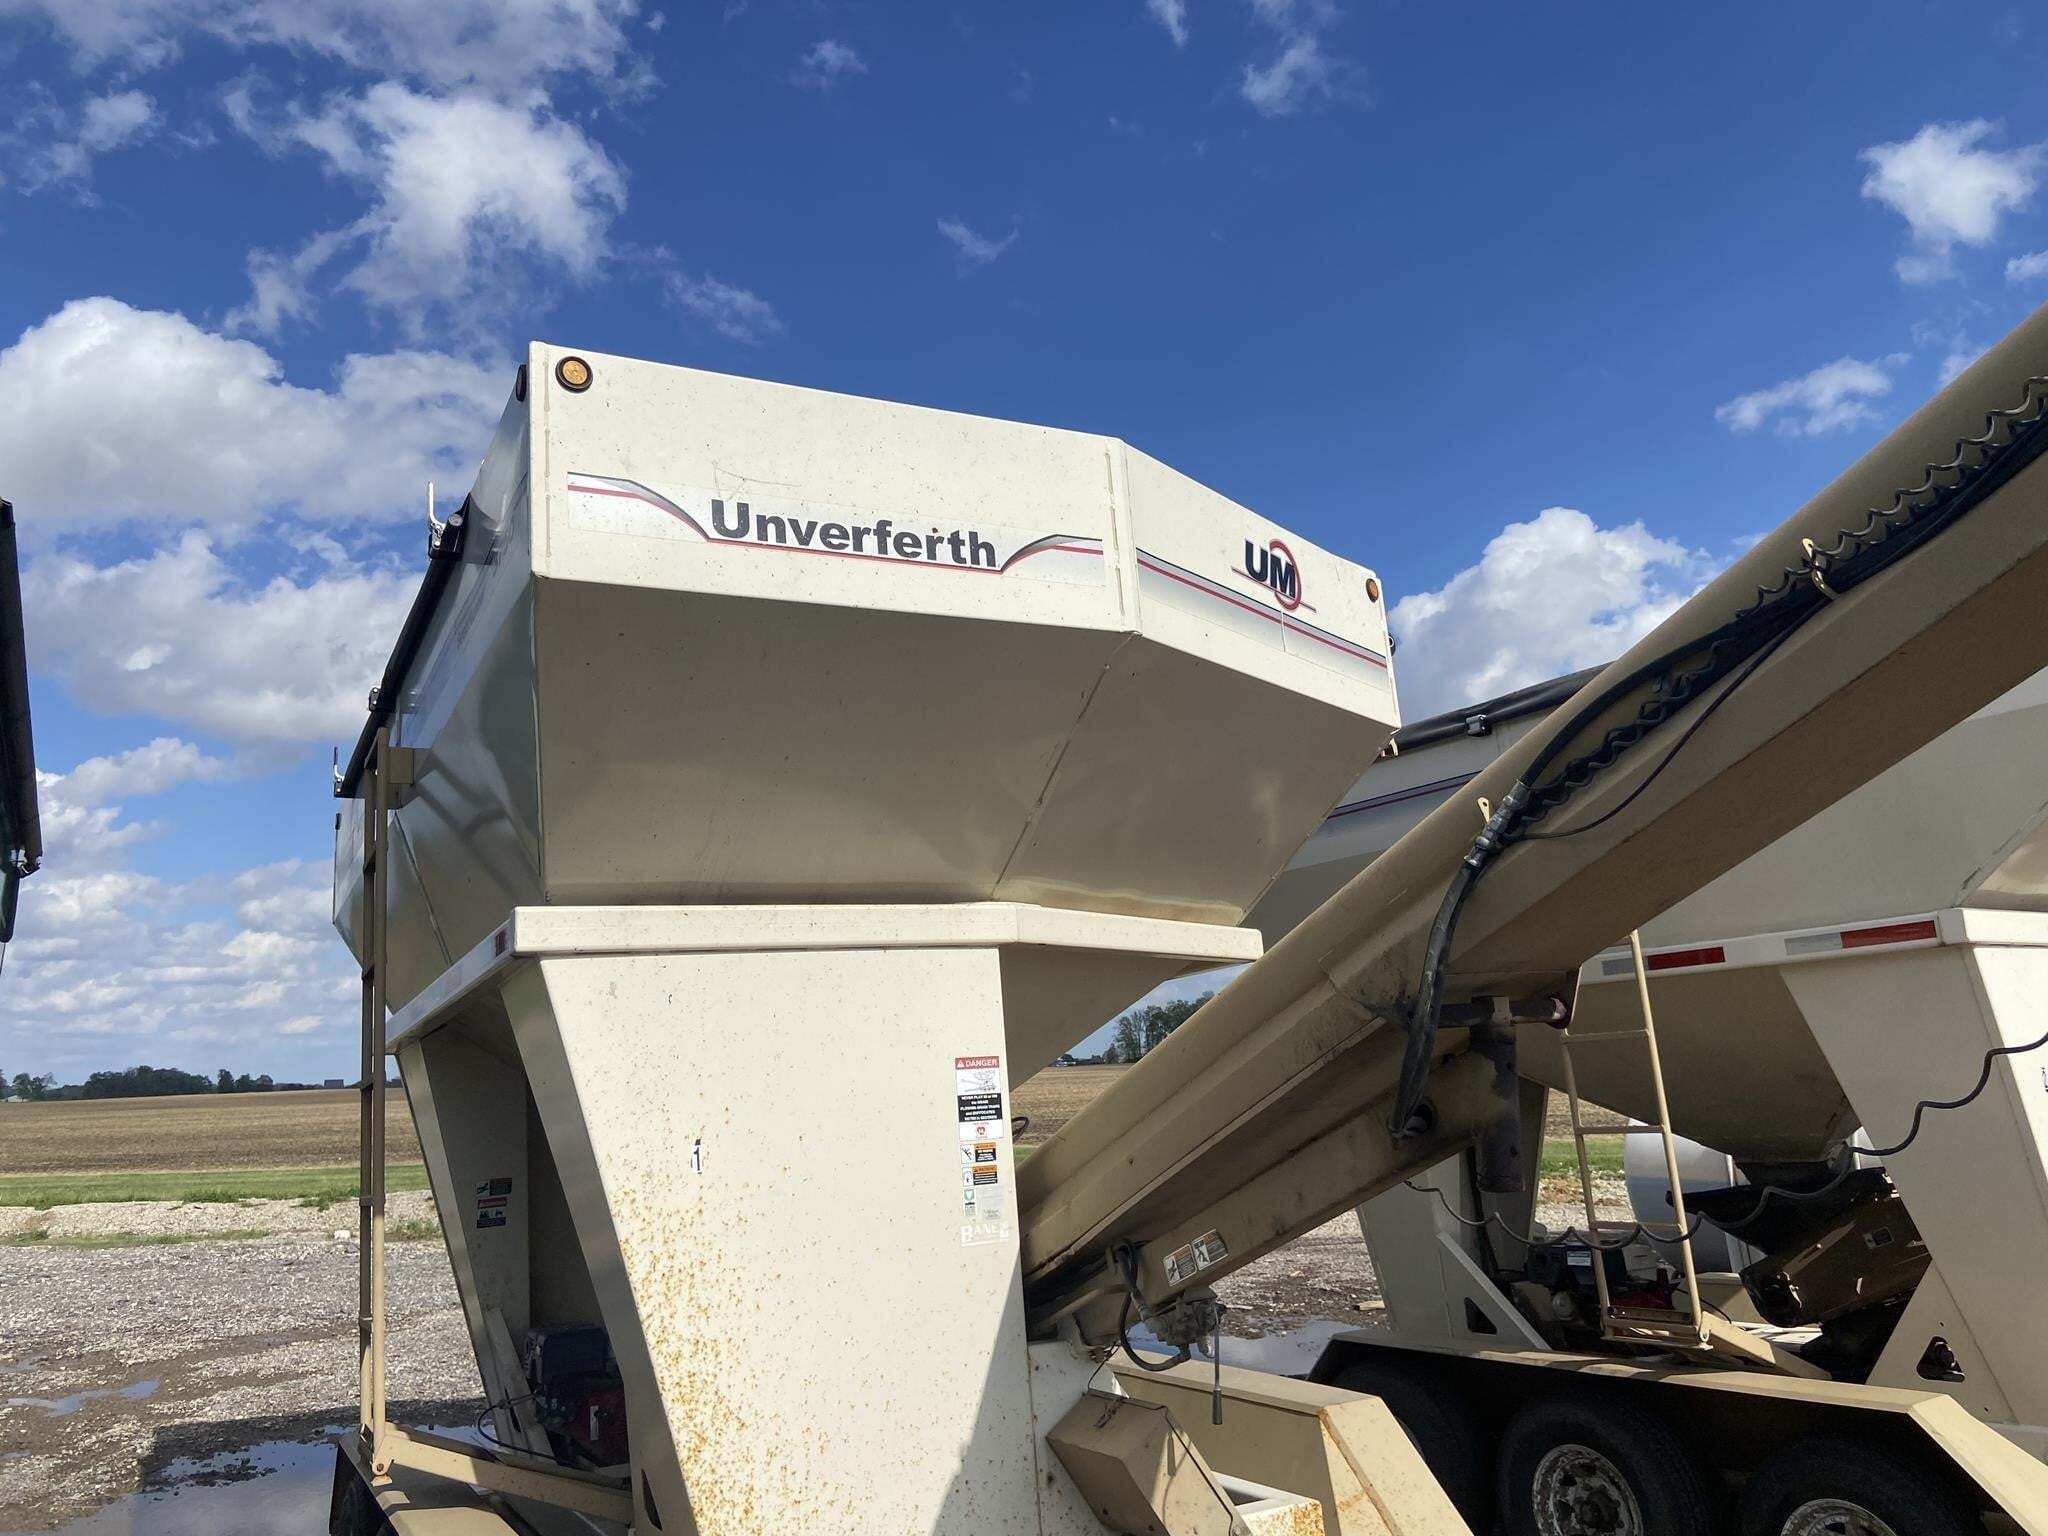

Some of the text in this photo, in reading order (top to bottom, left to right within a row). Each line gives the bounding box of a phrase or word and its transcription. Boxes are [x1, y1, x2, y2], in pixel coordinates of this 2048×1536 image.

[711, 498, 997, 568] Unverferth
[1244, 539, 1297, 600] UM
[965, 1058, 997, 1067] DANGER
